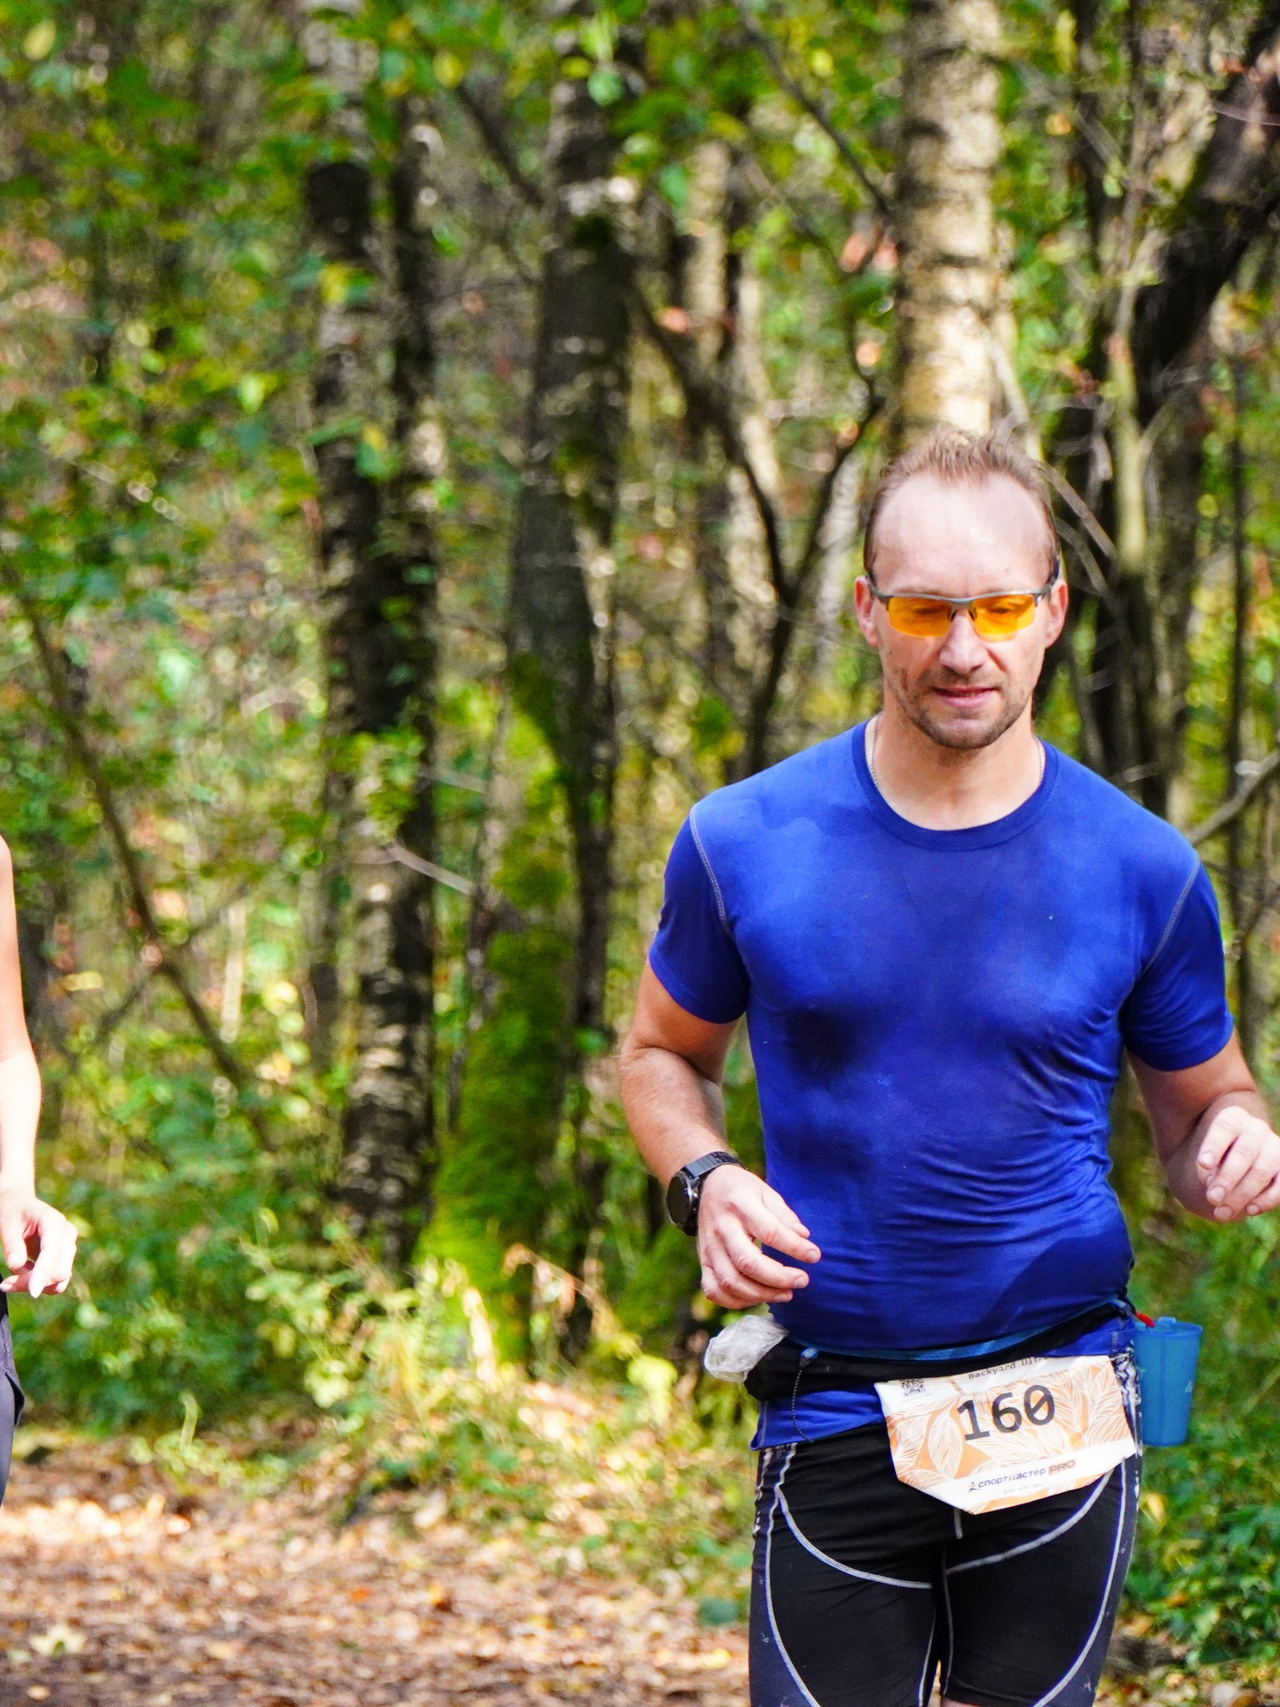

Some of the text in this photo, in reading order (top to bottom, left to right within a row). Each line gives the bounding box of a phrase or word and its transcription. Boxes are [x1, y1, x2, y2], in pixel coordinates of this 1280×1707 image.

[968, 1362, 1016, 1380] Backyard
[956, 1384, 1055, 1441] 160
[1048, 1459, 1076, 1475] PRO
